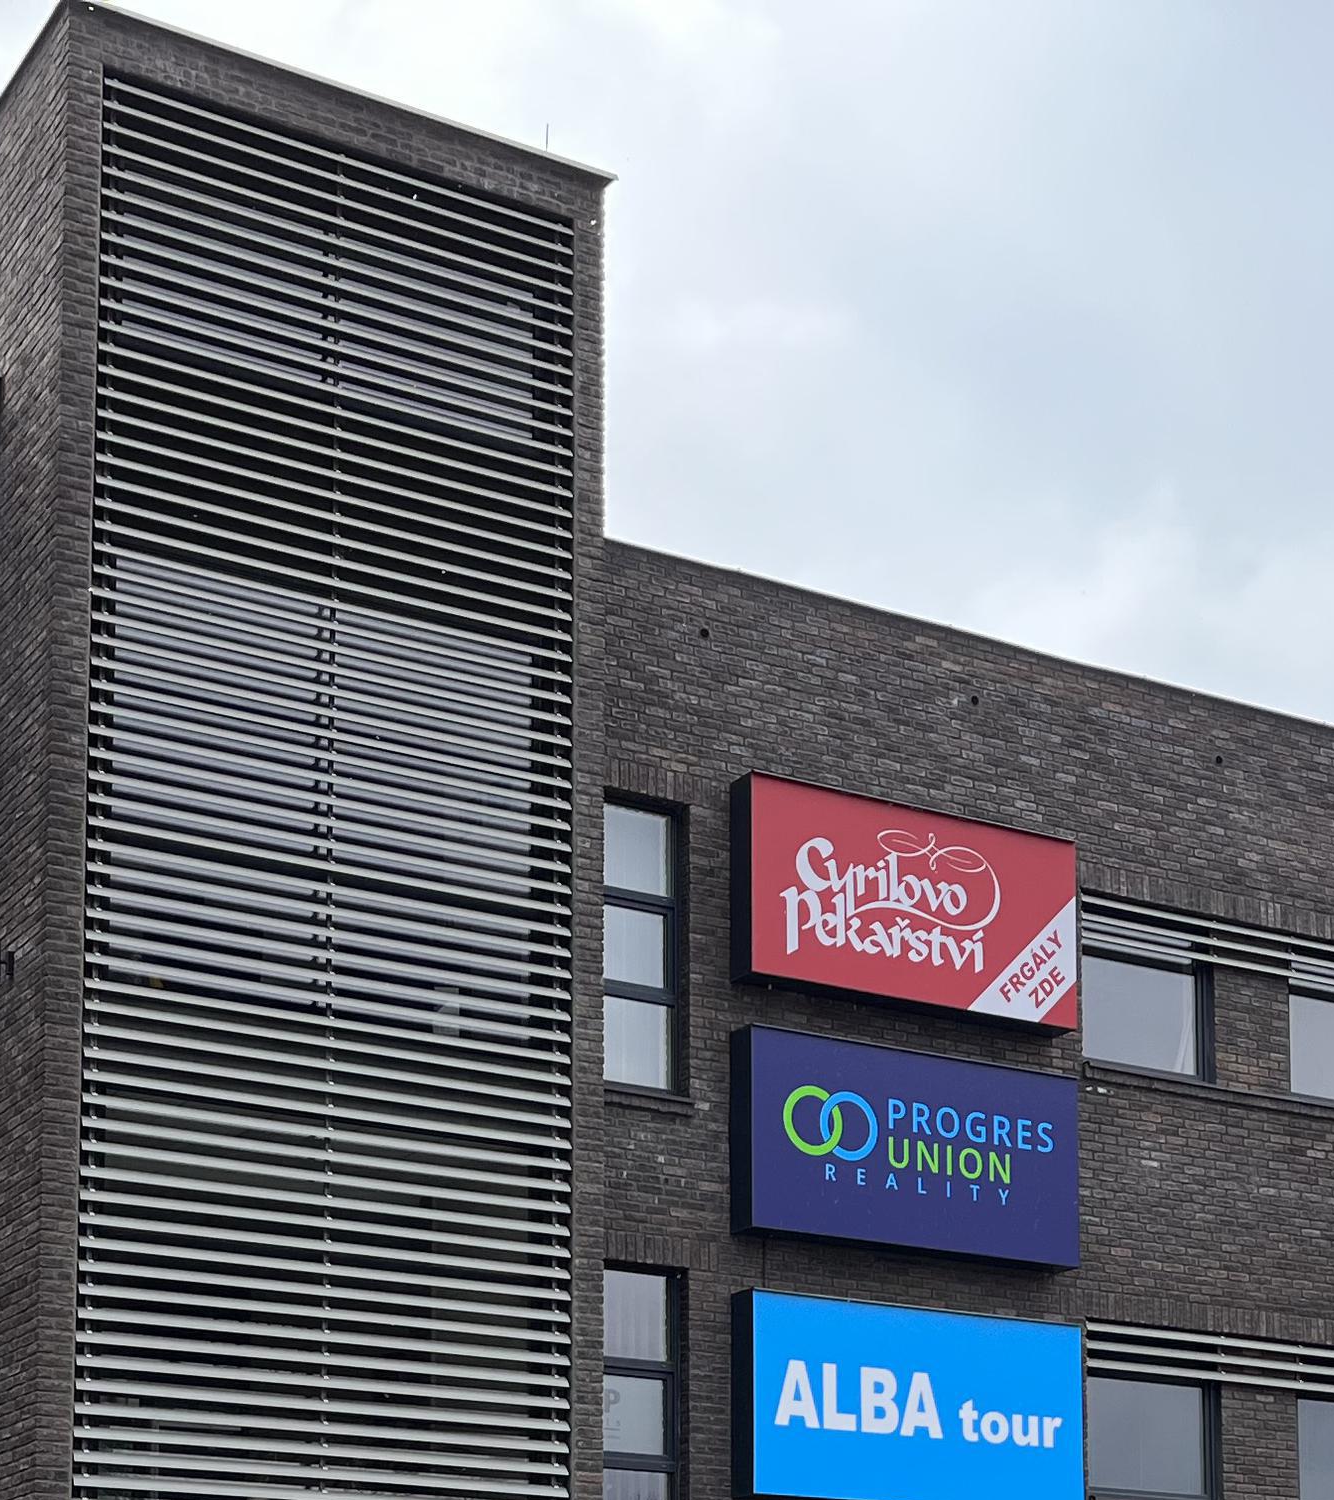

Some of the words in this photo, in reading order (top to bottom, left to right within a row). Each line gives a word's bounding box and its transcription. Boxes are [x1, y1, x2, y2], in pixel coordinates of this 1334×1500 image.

[794, 836, 969, 916] Cyrilovo
[779, 885, 986, 975] Pekařství
[997, 928, 1064, 1004] FRGÁLY
[1028, 965, 1066, 1010] ZDE
[887, 1097, 1055, 1155] PROGRES
[824, 1163, 1011, 1206] REALITY
[887, 1136, 1012, 1184] UNION
[774, 1358, 944, 1440] ALBA
[958, 1398, 1064, 1449] tour
